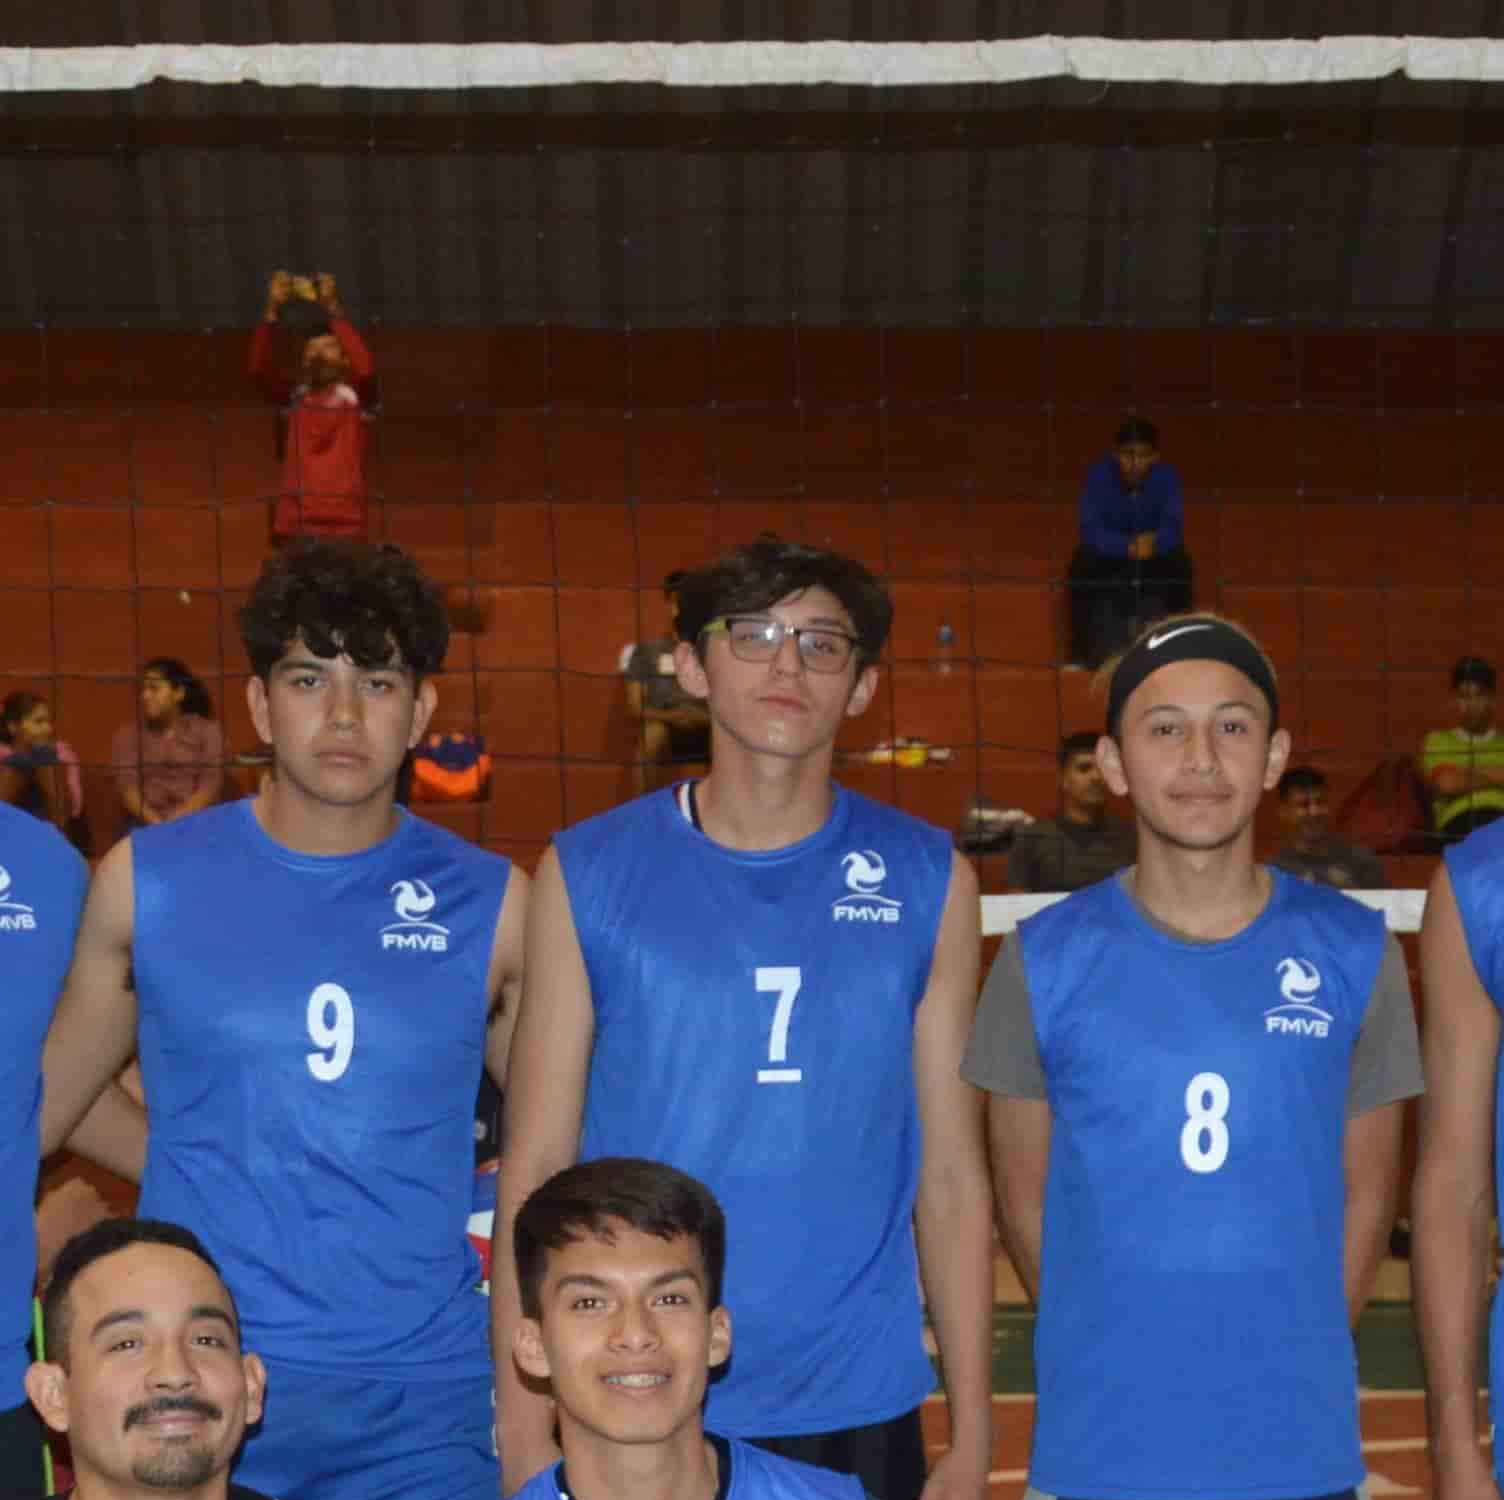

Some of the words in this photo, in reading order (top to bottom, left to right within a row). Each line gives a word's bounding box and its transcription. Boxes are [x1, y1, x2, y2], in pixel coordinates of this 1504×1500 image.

[382, 933, 447, 951] FMVB
[833, 905, 899, 923] FMVB
[306, 982, 355, 1082] 9
[754, 966, 801, 1062] 7
[1265, 1017, 1329, 1037] FMVB
[1180, 1071, 1230, 1173] 8
